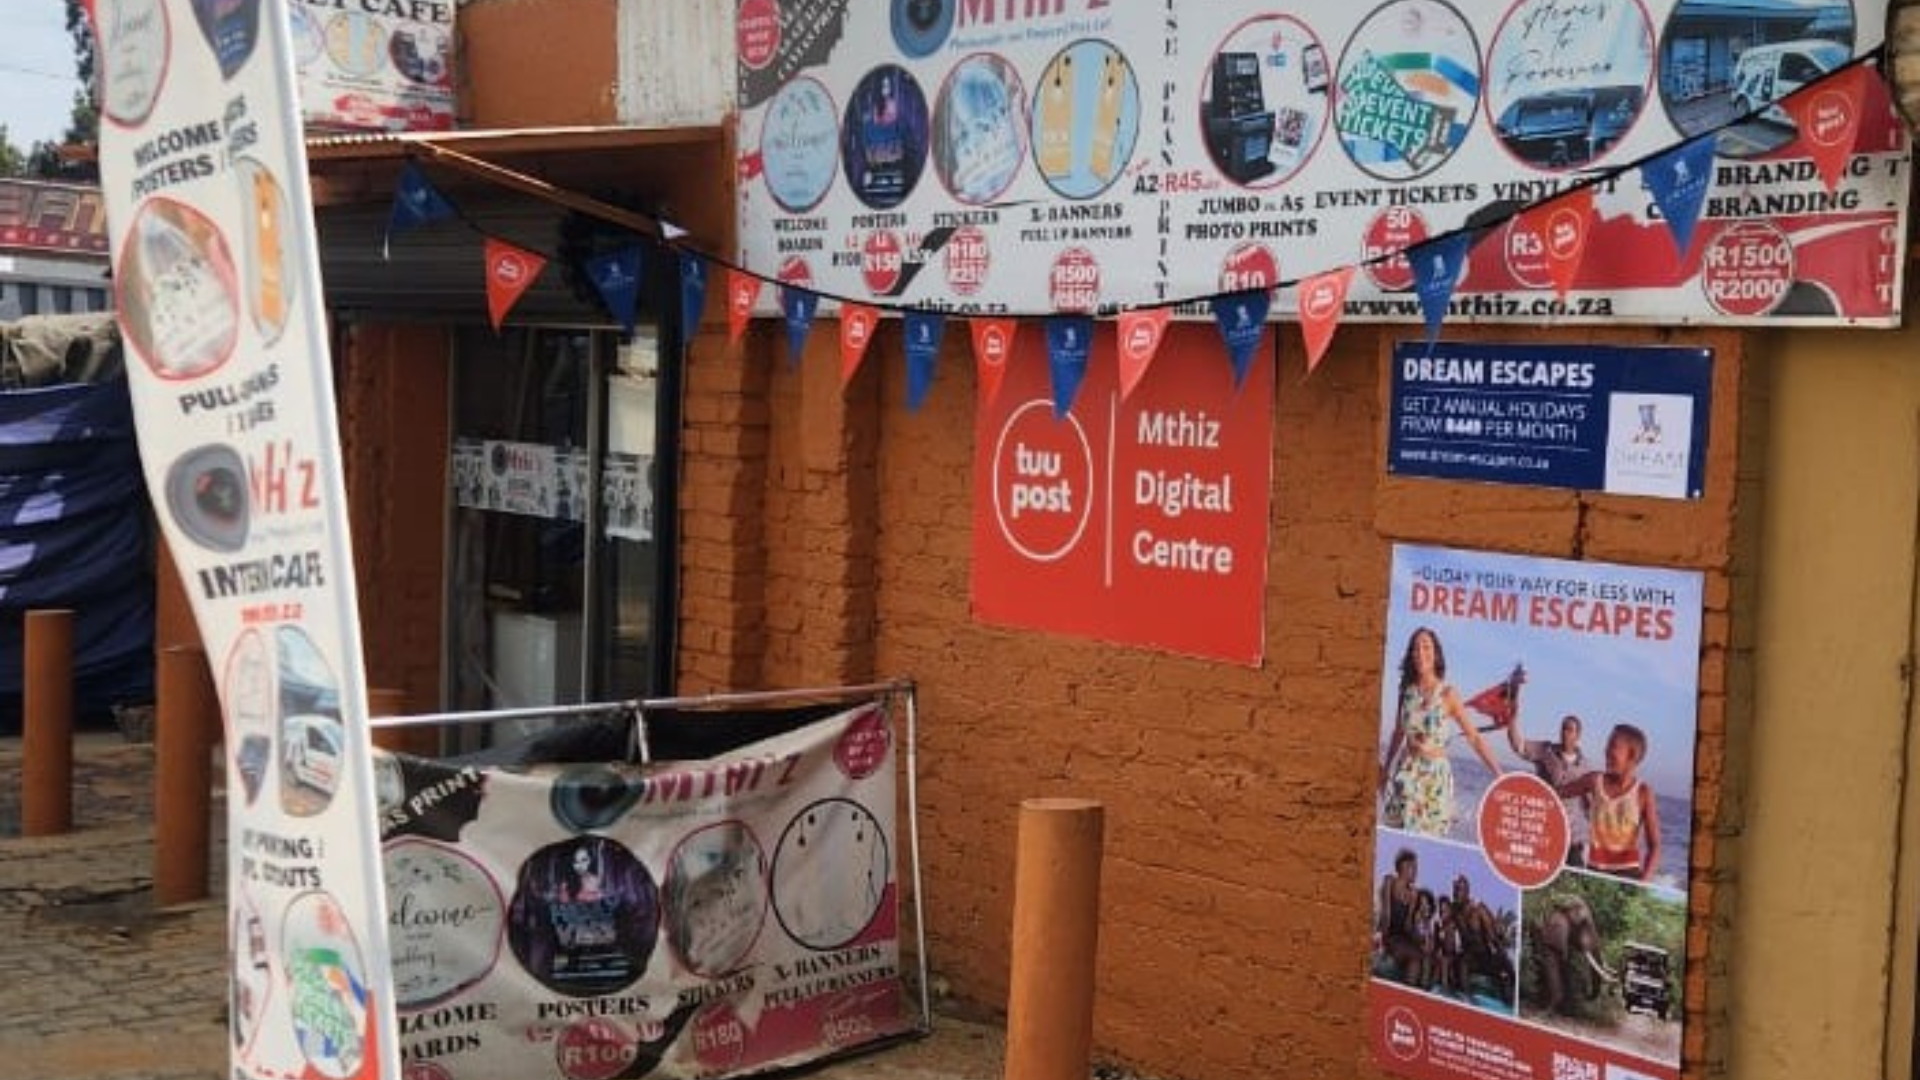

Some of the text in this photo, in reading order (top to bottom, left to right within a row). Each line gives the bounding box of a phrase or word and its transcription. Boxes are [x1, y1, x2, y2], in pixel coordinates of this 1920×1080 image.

[1198, 197, 1260, 215] JUMBO
[1316, 184, 1479, 210] EVENT TICKETS
[852, 213, 907, 228] POSTERS
[933, 211, 998, 226] STICKERS
[1185, 220, 1318, 240] PHOTO PRINTS
[1709, 245, 1790, 267] R1500
[1710, 278, 1786, 300] R2000
[1403, 357, 1596, 388] DREAM ESCAPES
[1401, 396, 1587, 421] GET 2 ANNUAL HOLIDAYS
[1136, 411, 1221, 449] Mthiz
[1400, 415, 1441, 434] FROM
[1485, 421, 1514, 439] PER
[1516, 421, 1579, 443] MONTH
[1014, 443, 1062, 478] tuu
[1011, 480, 1073, 519] post
[1134, 470, 1233, 518] Digital
[1132, 530, 1234, 575] Centre
[1475, 570, 1518, 590] YOUR
[1519, 574, 1552, 593] WAY
[1555, 578, 1588, 598] FOR
[1591, 583, 1630, 603] LESS
[1632, 586, 1677, 607] WITH
[1410, 582, 1677, 641] DREAM ESCAPES
[410, 765, 482, 816] PRINT
[400, 1002, 499, 1036] LCOME
[536, 995, 651, 1018] POSTERS
[400, 1031, 482, 1062] ARDS
